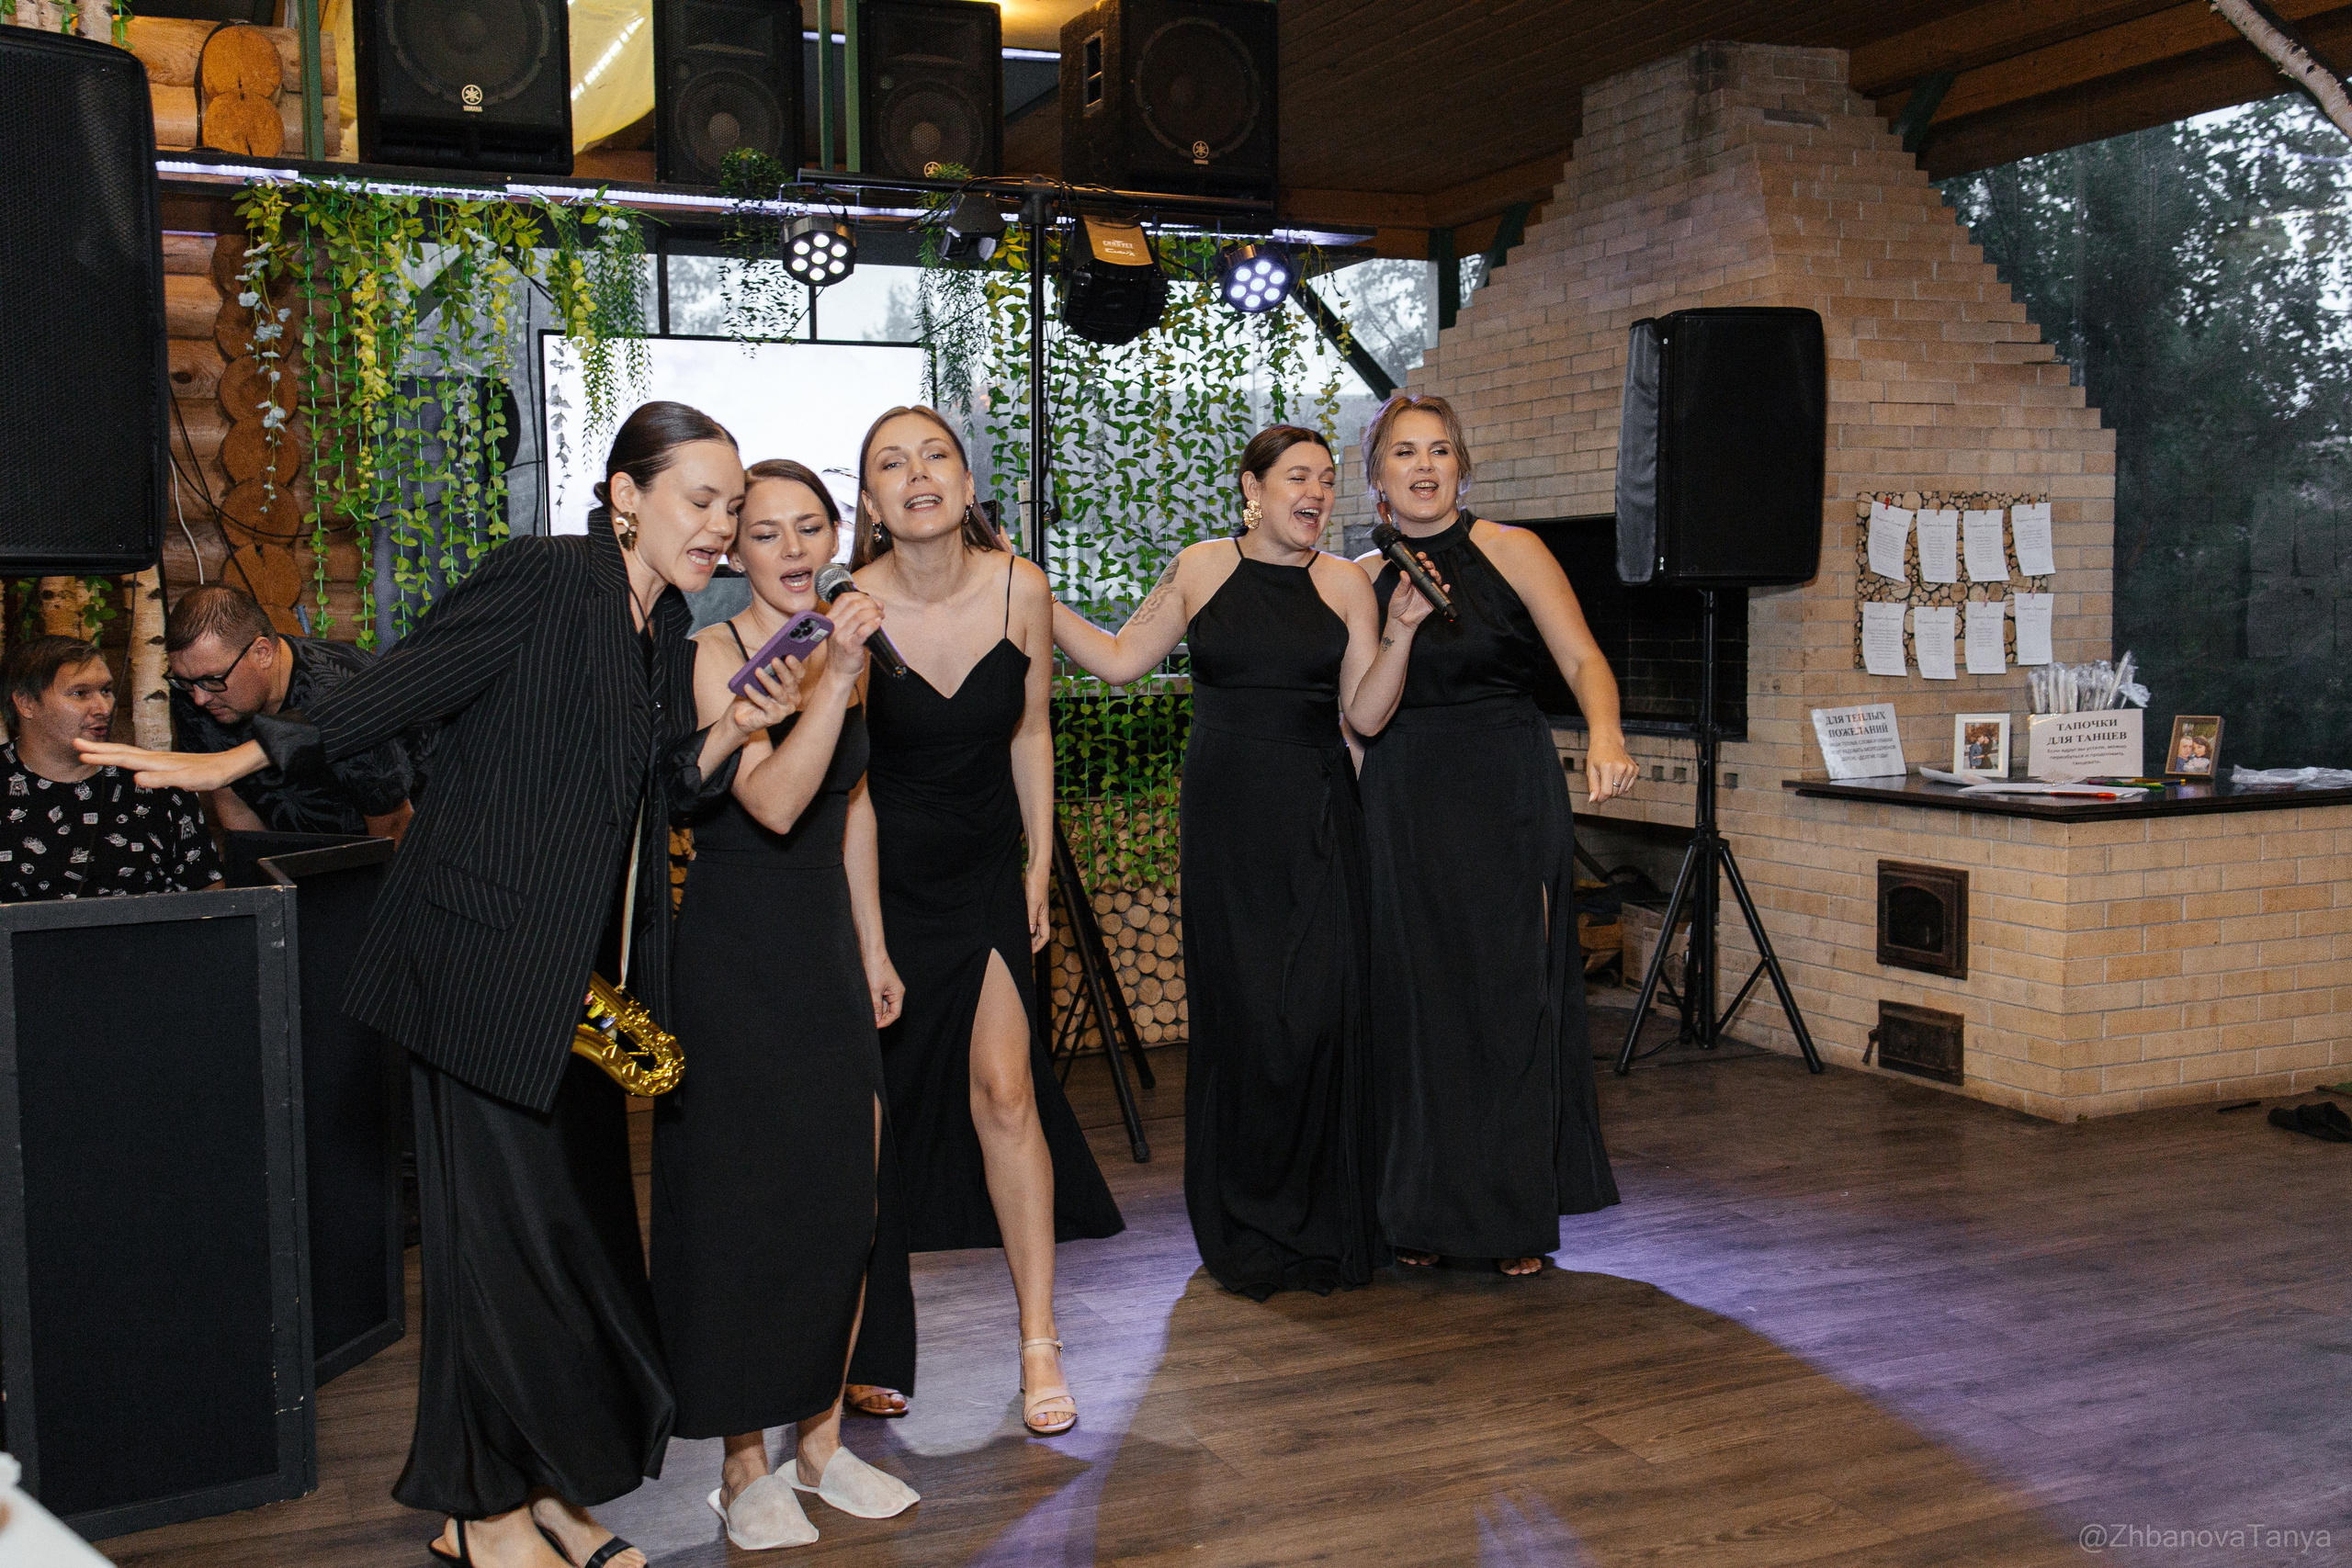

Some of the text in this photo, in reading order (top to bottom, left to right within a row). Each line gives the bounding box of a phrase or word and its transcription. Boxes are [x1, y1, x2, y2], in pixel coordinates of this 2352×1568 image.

[1826, 711, 1886, 726] ДЛЯ ТЕПЛЫХ
[2057, 718, 2118, 731] ТАПОЧКИ
[1828, 722, 1889, 738] ПОЖЕЛАНИЙ
[2046, 731, 2127, 746] ДЛЯ ТАНЦЕВ
